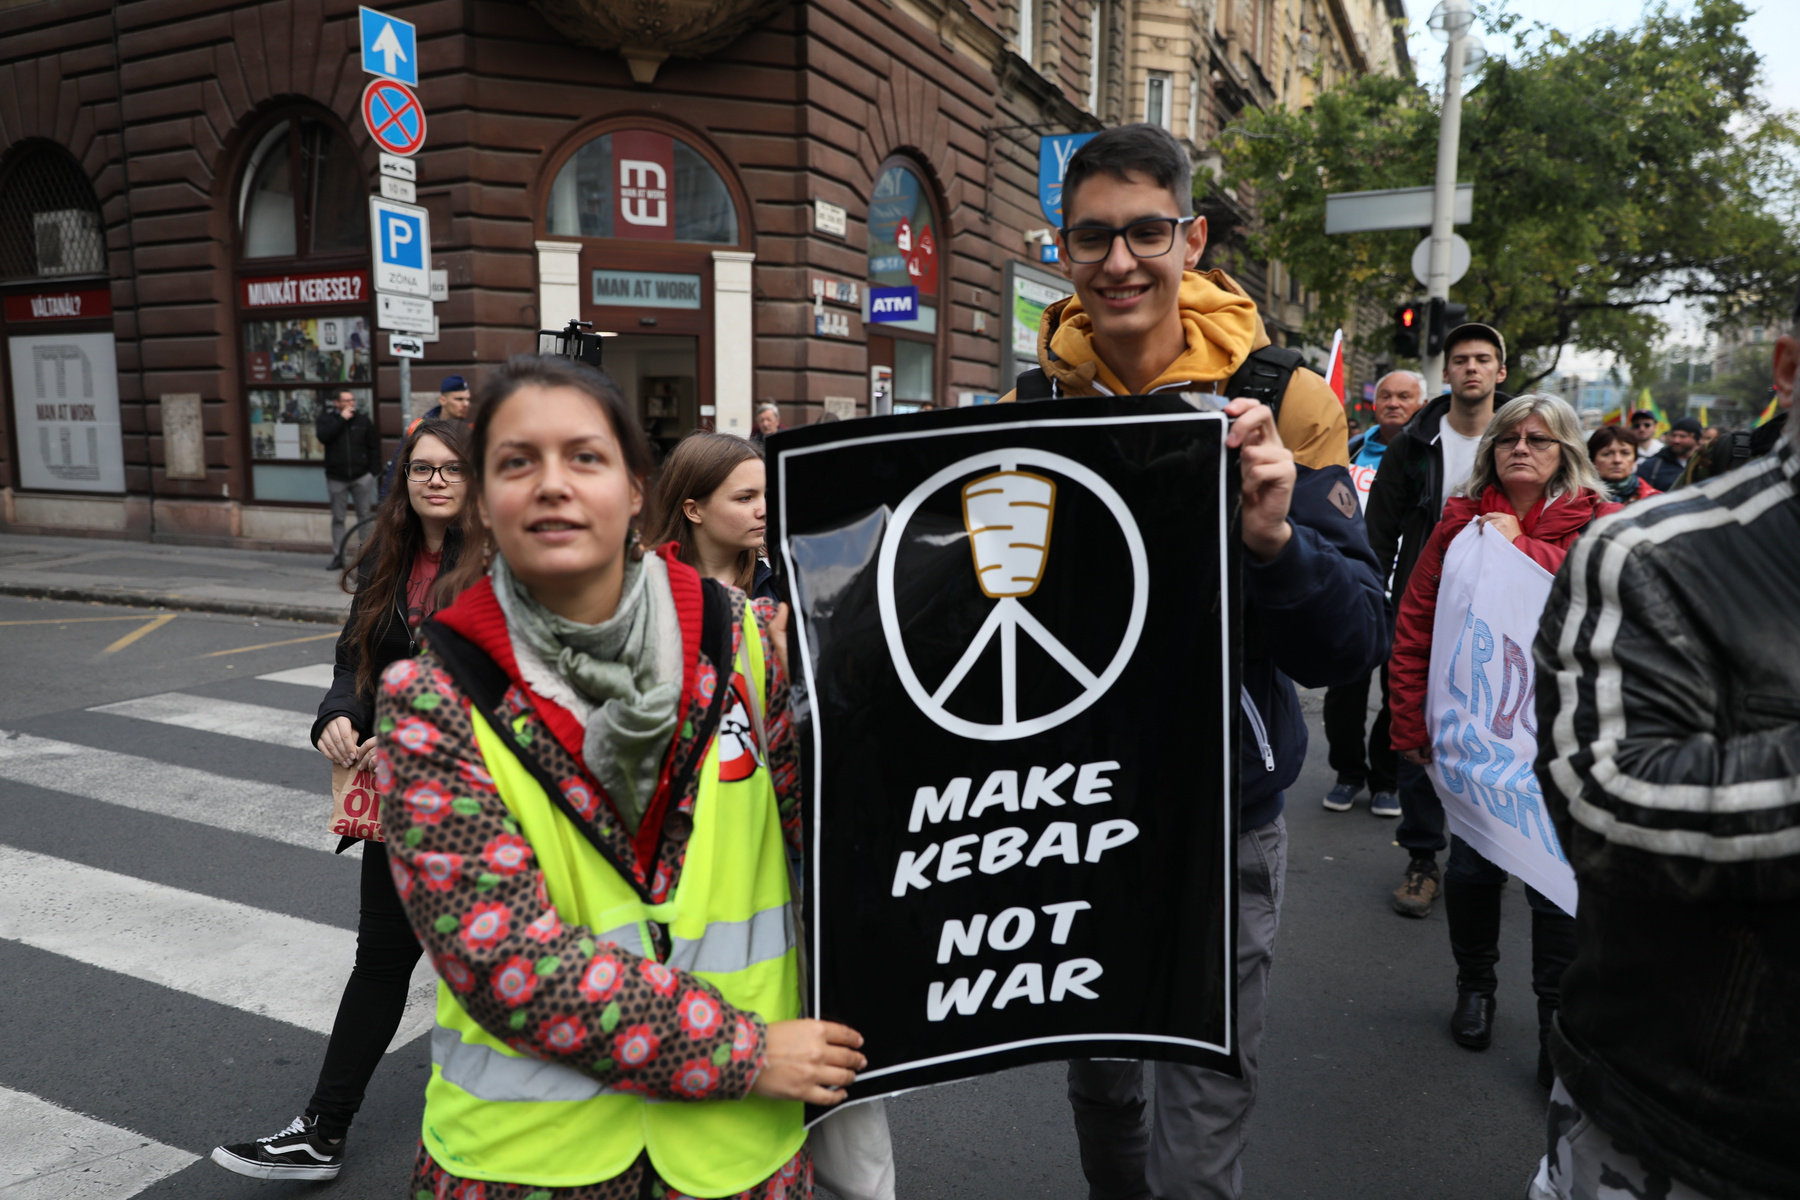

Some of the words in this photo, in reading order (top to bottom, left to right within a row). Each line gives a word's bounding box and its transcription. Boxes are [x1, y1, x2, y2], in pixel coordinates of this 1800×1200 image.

[388, 217, 413, 259] P
[30, 293, 81, 318] VÁLTANÁL?
[248, 276, 298, 305] MUNKÁT
[299, 276, 362, 303] KERESEL?
[596, 278, 630, 298] MAN
[633, 279, 652, 298] AT
[655, 280, 698, 300] WORK
[872, 295, 912, 313] ATM
[36, 404, 56, 421] MAN
[58, 404, 69, 421] AT
[70, 404, 96, 421] WORK
[908, 760, 1121, 833] MAKE
[892, 818, 1140, 897] KEBAP
[936, 900, 1092, 964] NOT
[926, 957, 1104, 1022] WAR
